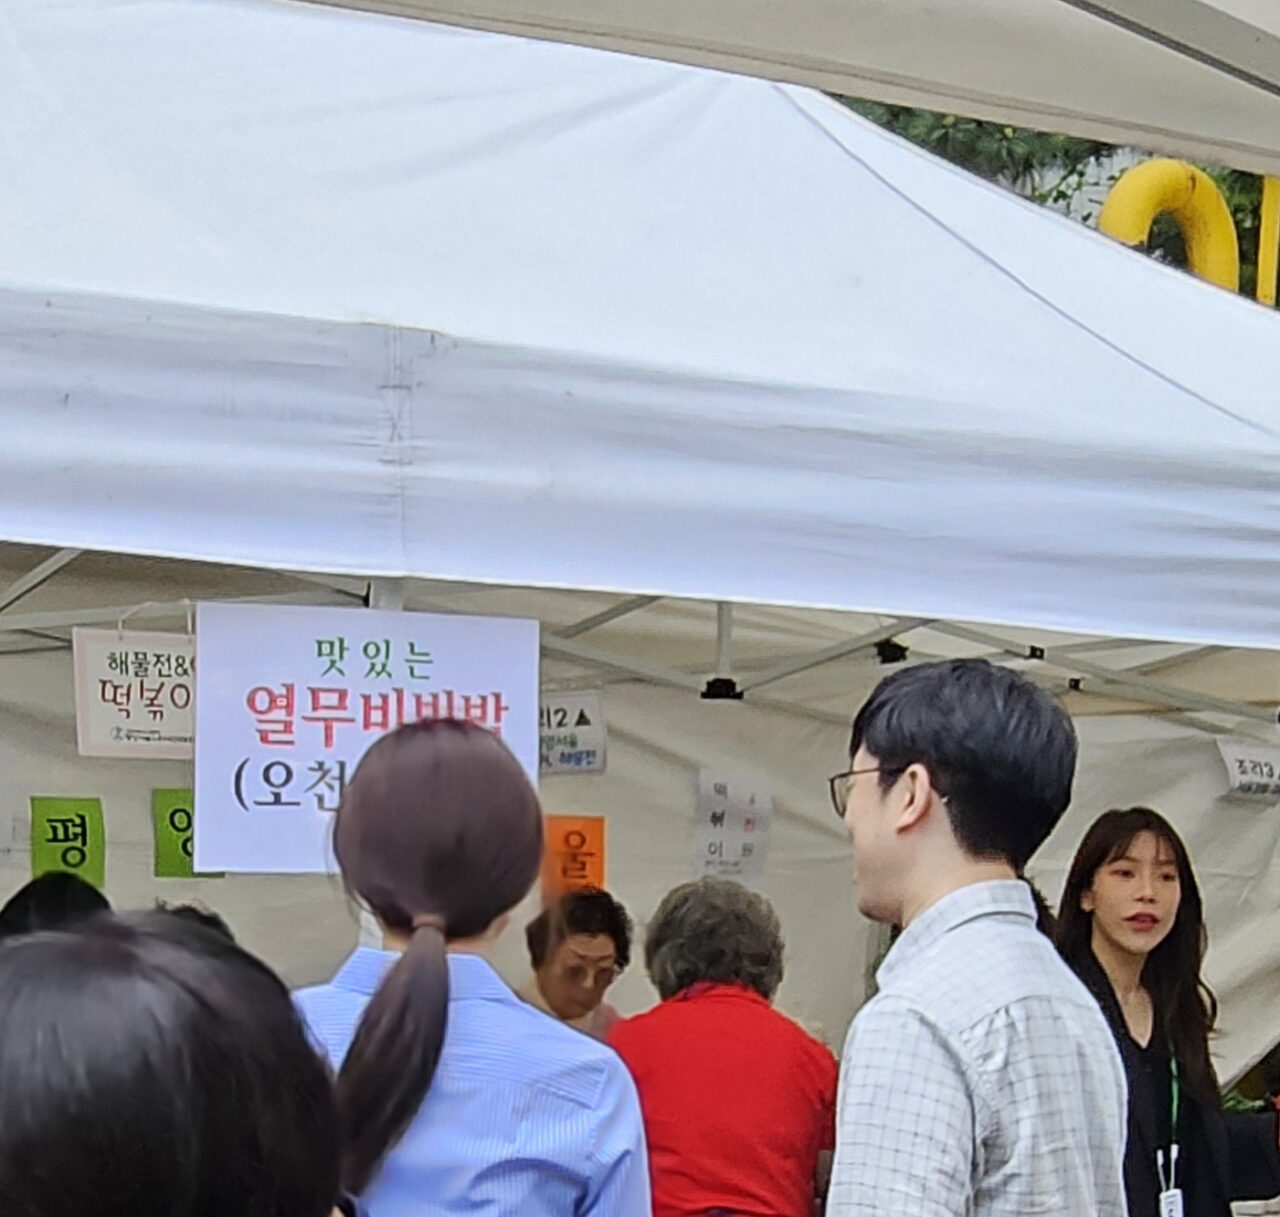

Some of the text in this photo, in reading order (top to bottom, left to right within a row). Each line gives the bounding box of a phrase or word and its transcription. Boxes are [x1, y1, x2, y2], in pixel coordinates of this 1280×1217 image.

[315, 637, 434, 680] 맛있는
[234, 757, 347, 813] (오천
[45, 813, 88, 868] 평
